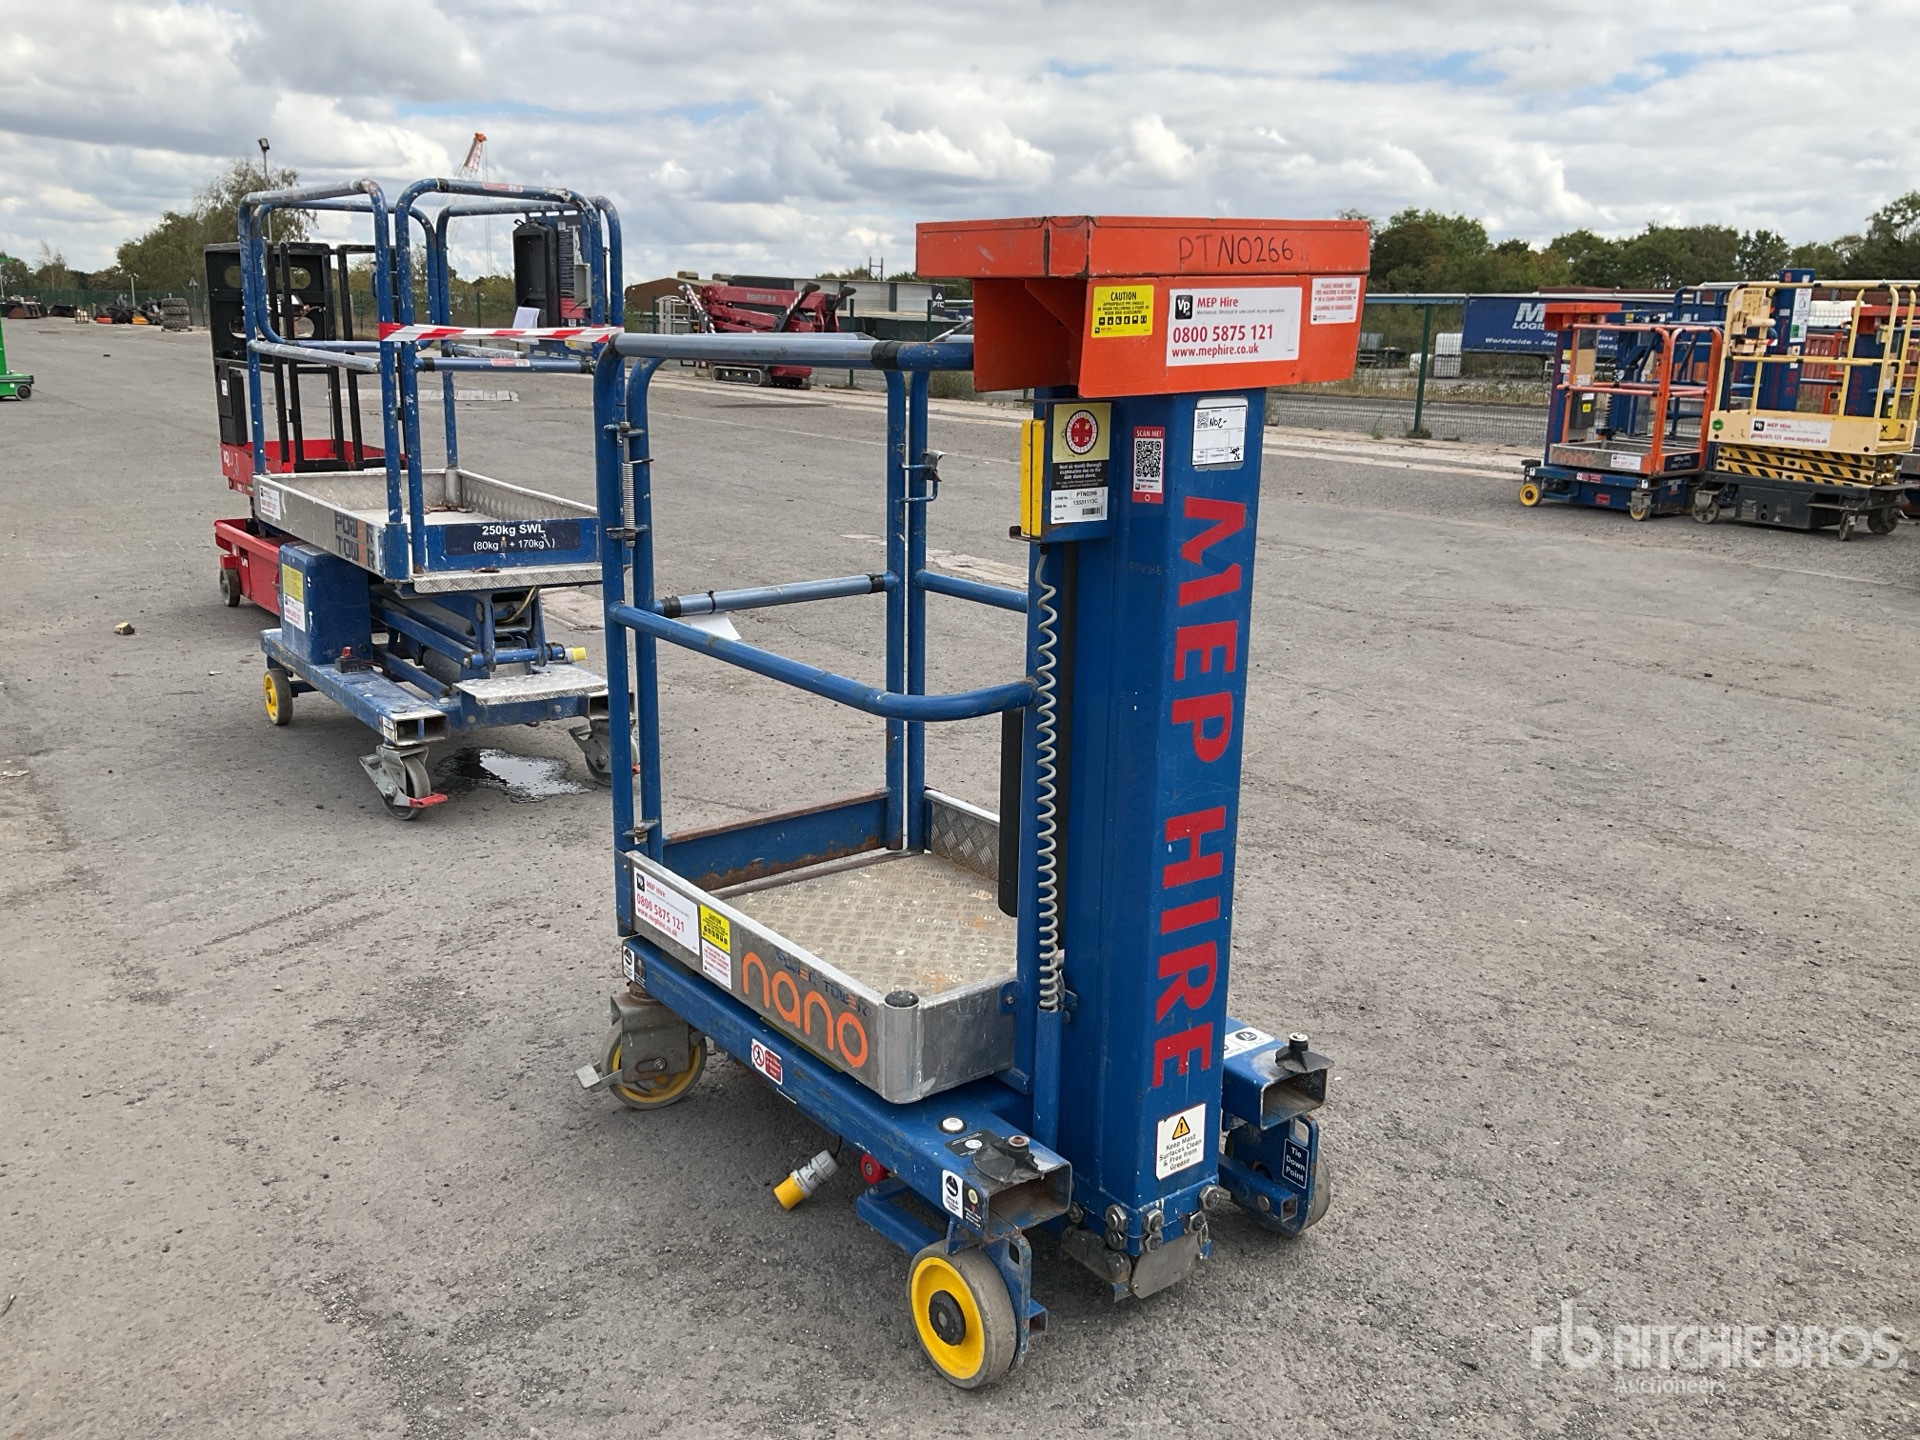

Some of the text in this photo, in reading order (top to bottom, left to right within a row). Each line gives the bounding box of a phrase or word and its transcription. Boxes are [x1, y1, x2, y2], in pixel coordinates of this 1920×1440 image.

[1110, 291, 1137, 301] CAUTION
[1197, 296, 1239, 308] MEP Hire
[1177, 299, 1190, 313] Vp
[1173, 324, 1273, 343] 0800 5875 121
[1485, 337, 1532, 345] Worldwide
[1172, 342, 1259, 358] www.mephire.co.uk
[335, 511, 374, 543] POWER
[482, 524, 545, 536] 250kg SWL
[336, 535, 376, 570] TOWER
[473, 541, 499, 552] (80kg
[518, 539, 545, 549] 170kg
[1172, 496, 1247, 763] MEP
[637, 893, 653, 911] 0800
[654, 904, 670, 923] 5875
[672, 915, 685, 932] 121
[1153, 805, 1226, 1088] HIRE
[742, 951, 868, 1068] nano
[1159, 1139, 1202, 1161] Surfaces Clean
[1166, 1134, 1196, 1150] Keep Mast
[1169, 1155, 1182, 1164] Free
[1183, 1148, 1197, 1157] from
[1291, 1146, 1302, 1158] Tie
[1169, 1158, 1190, 1171] Grease
[1286, 1155, 1305, 1171] Down
[1285, 1166, 1304, 1182] Point
